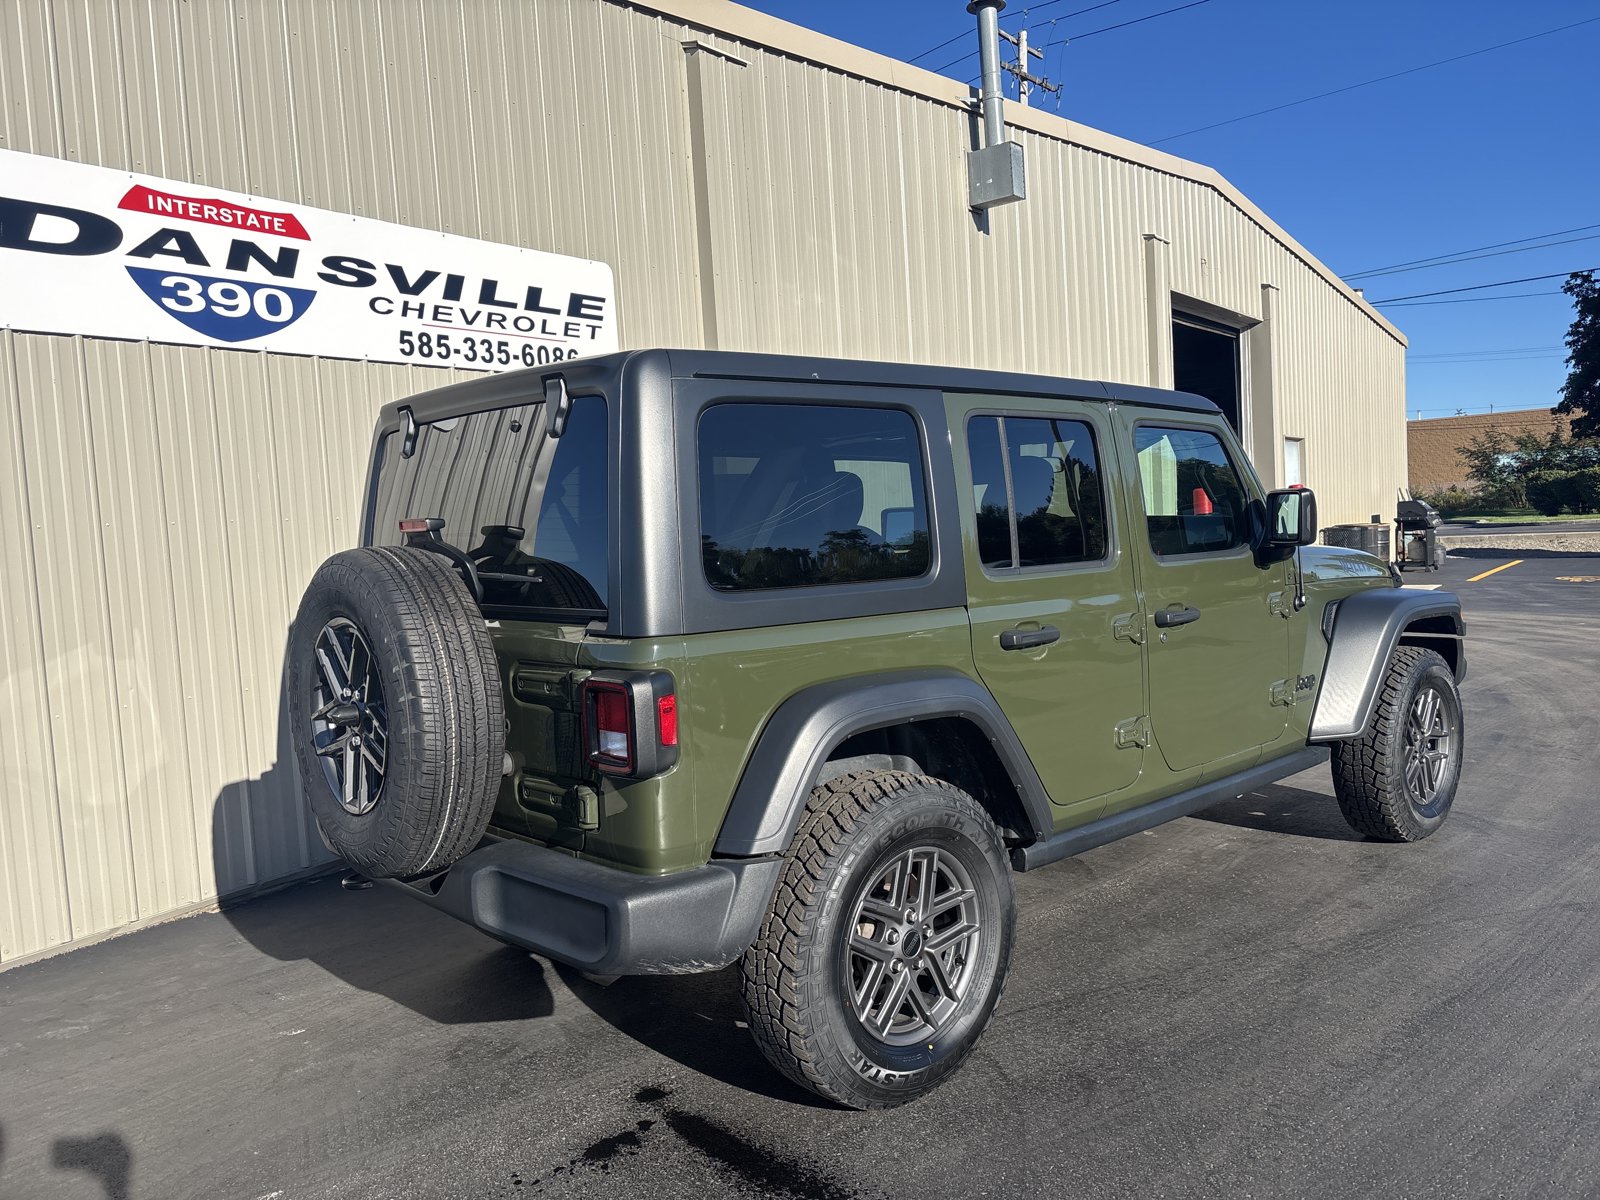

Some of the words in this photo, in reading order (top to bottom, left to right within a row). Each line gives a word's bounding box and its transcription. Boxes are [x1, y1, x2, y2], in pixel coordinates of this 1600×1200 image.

[147, 193, 287, 233] INTERSTATE
[0, 196, 607, 322] DANSVILLE
[160, 275, 294, 323] 390
[368, 297, 603, 340] CHEVROLET
[1296, 674, 1315, 692] Jeep
